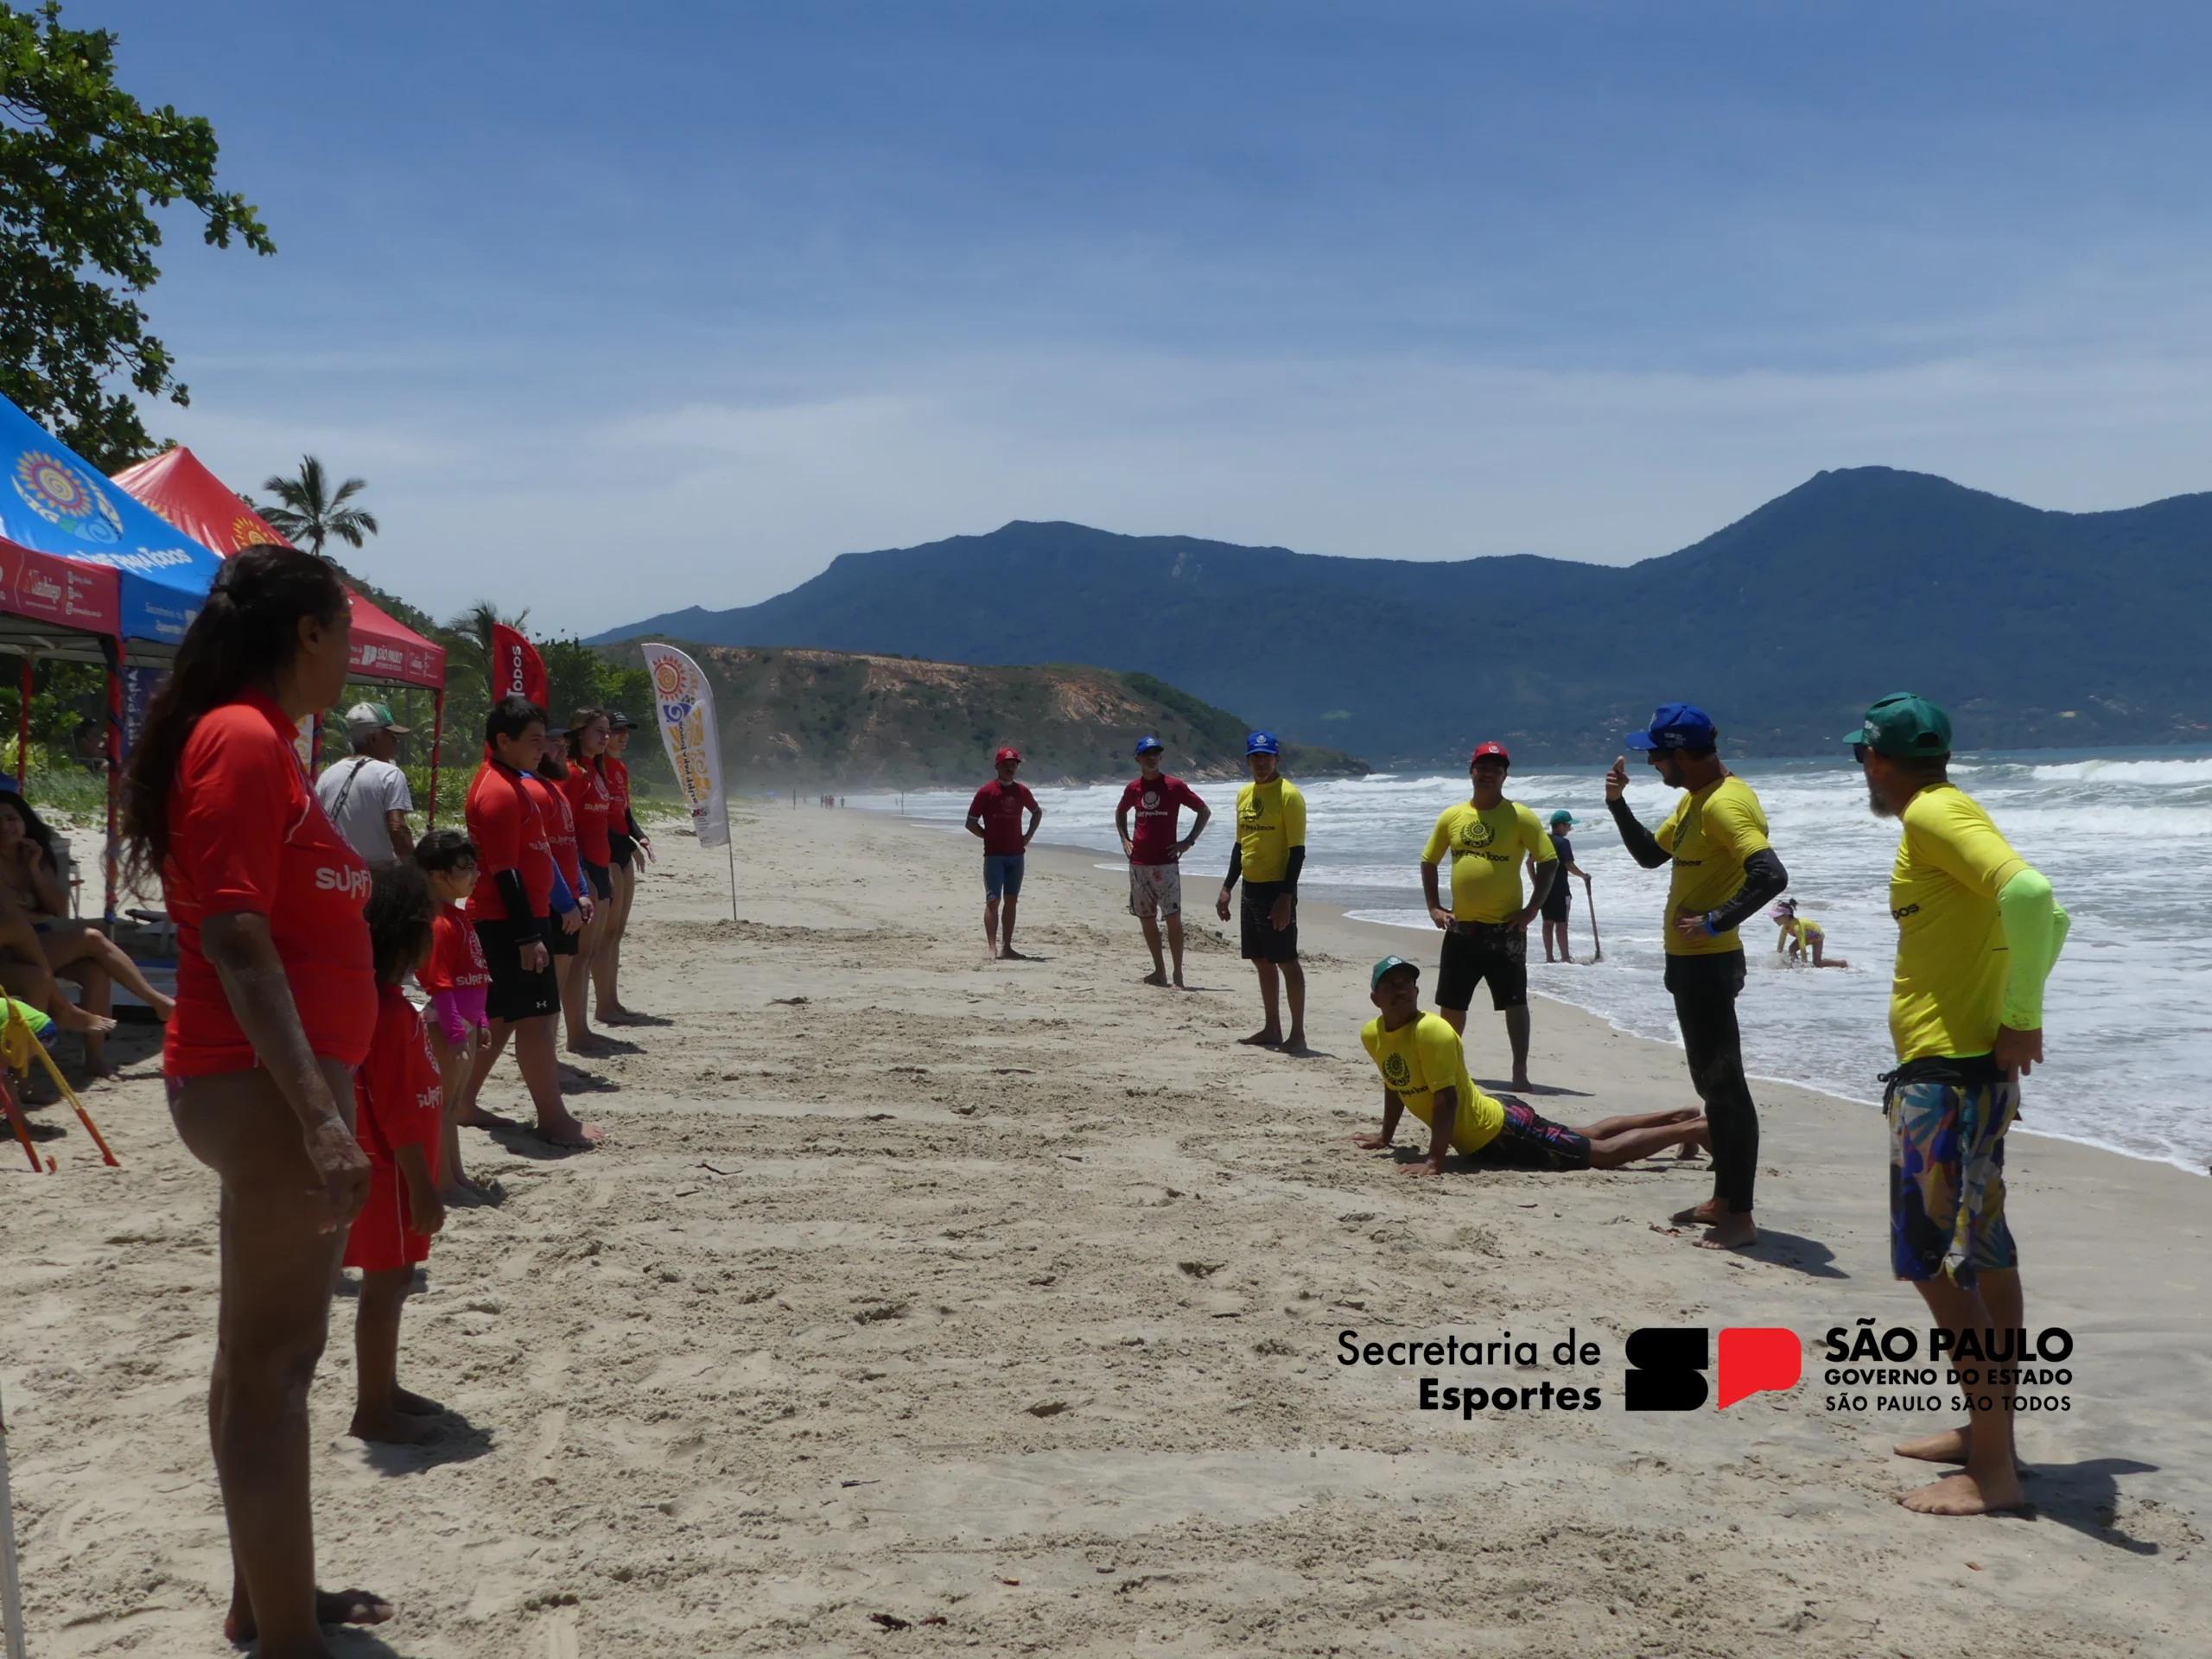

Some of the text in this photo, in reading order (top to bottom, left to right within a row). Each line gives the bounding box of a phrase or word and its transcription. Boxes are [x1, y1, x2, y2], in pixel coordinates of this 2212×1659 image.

[137, 547, 193, 569] TODOS
[506, 645, 525, 697] TODOS
[687, 777, 698, 804] SURF
[1485, 851, 1510, 862] TODOS
[315, 864, 369, 899] SURF
[455, 973, 483, 985] SURF
